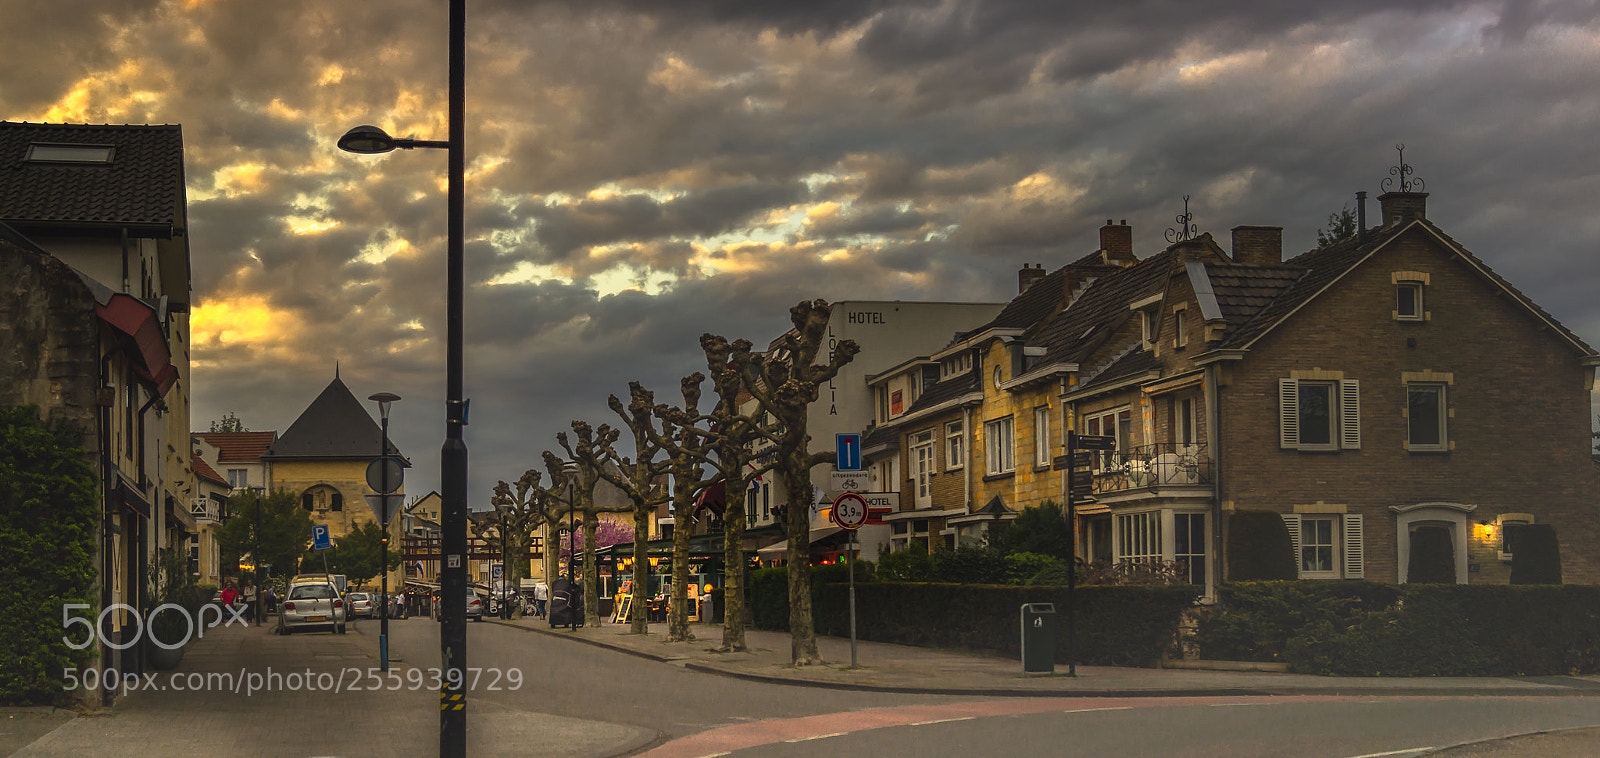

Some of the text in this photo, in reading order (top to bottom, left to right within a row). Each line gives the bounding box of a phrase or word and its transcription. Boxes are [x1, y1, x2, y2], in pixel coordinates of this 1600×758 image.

[848, 312, 886, 324] HOTEL
[828, 326, 838, 416] LOLIA
[315, 527, 325, 540] P
